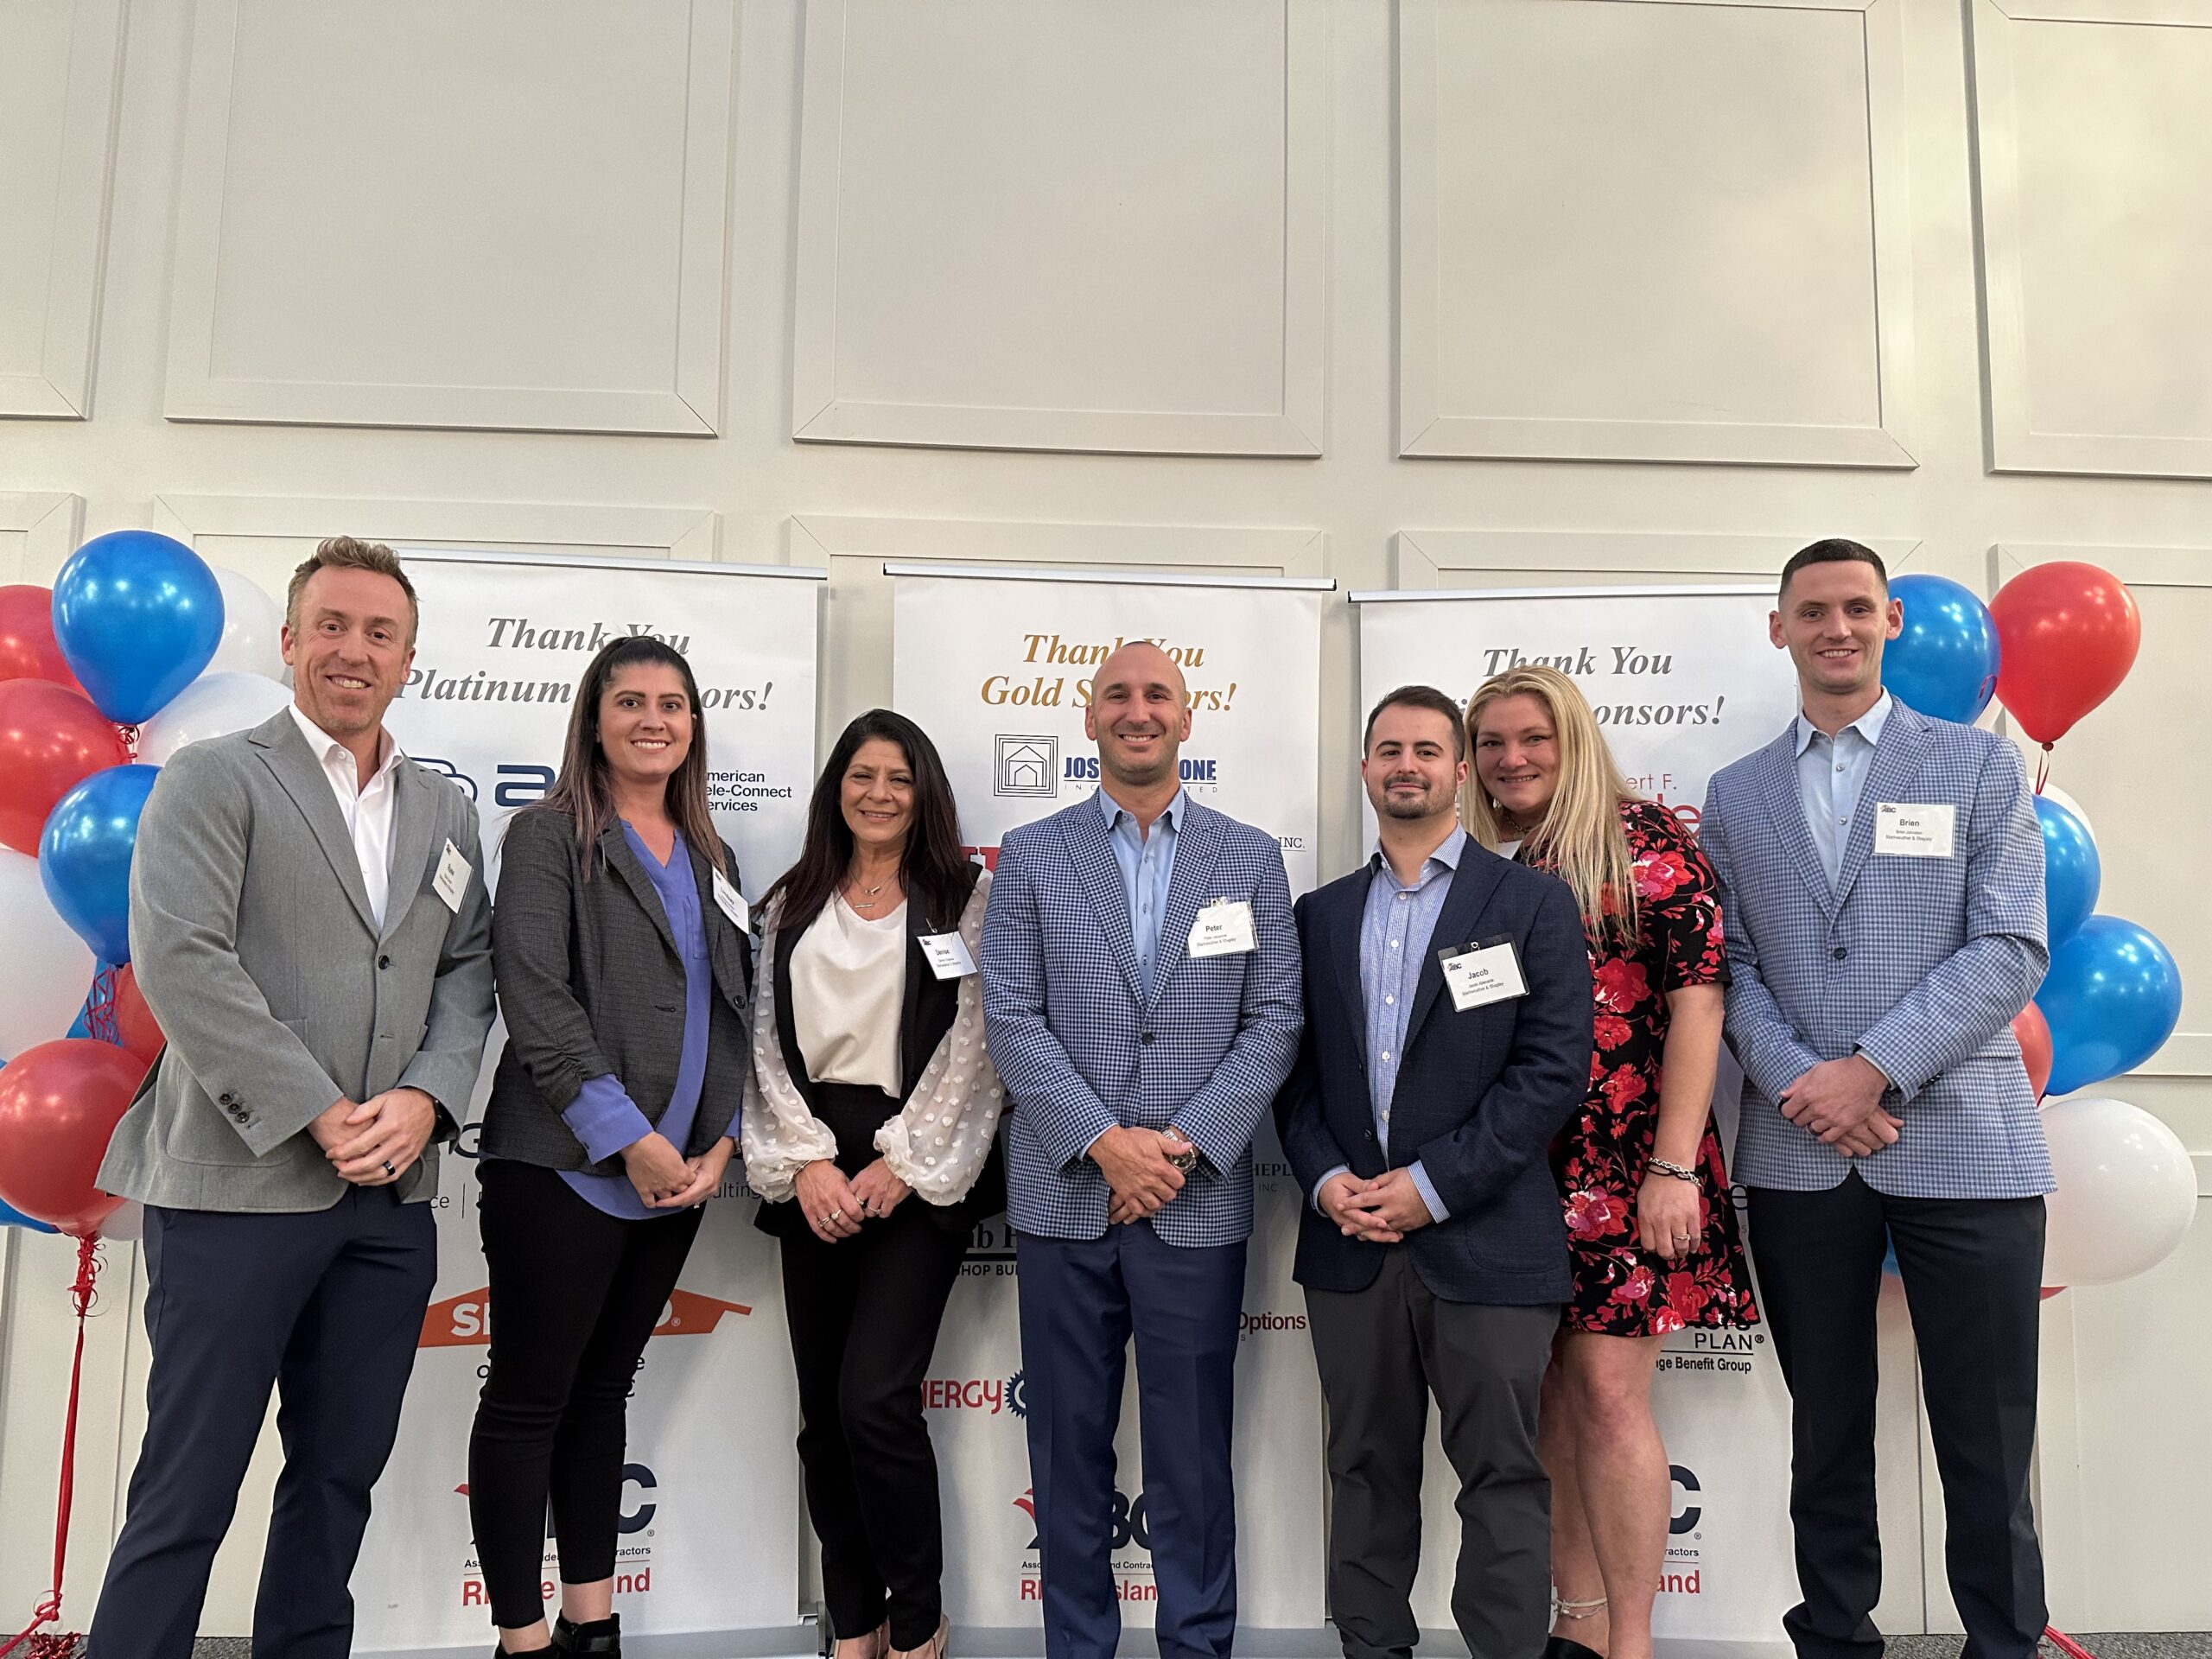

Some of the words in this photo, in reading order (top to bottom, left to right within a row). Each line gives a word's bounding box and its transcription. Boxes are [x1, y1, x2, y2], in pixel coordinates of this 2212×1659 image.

[486, 618, 611, 652] Thank
[1023, 634, 1123, 665] Than
[1611, 646, 1672, 675] You
[393, 669, 571, 703] Platinum
[981, 676, 1065, 707] Gold
[1593, 696, 1725, 726] onsors!
[707, 770, 765, 783] merican
[1064, 757, 1099, 779] JOS
[1625, 773, 1654, 790] ert
[1662, 773, 1677, 790] F.
[706, 784, 792, 798] ele-Connect
[708, 798, 758, 811] ervices
[1899, 818, 1920, 827] Brien
[1278, 836, 1306, 849] INC.
[1468, 969, 1489, 980] Jacob
[1675, 1357, 1714, 1370] Benefit
[1717, 1358, 1751, 1374] Group
[1665, 1548, 1699, 1557] ractors
